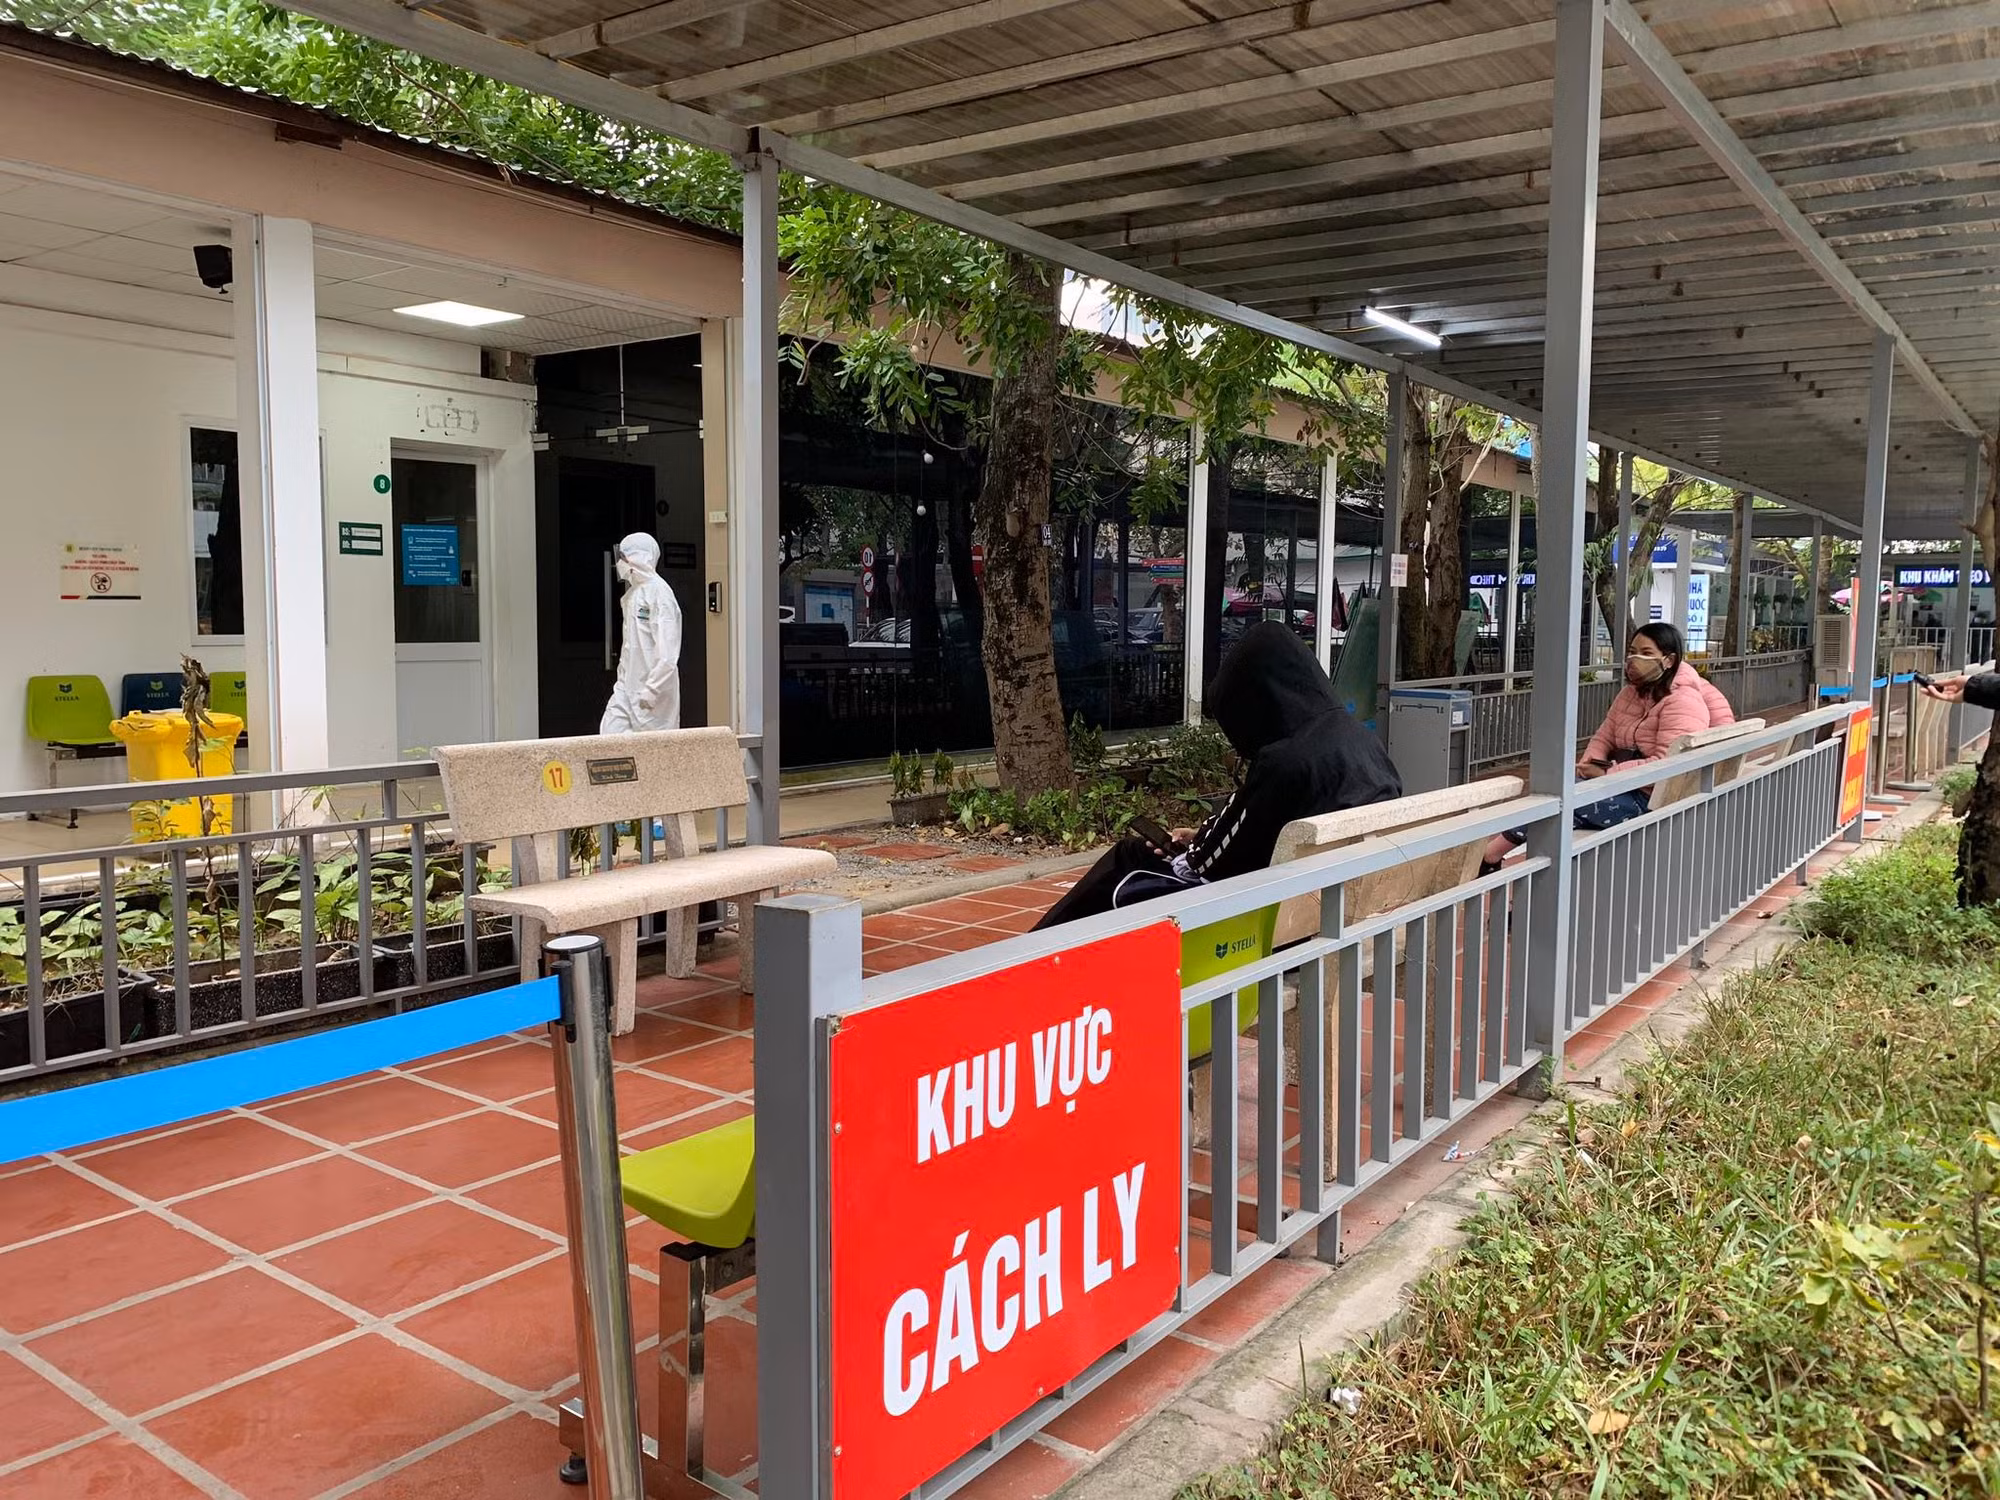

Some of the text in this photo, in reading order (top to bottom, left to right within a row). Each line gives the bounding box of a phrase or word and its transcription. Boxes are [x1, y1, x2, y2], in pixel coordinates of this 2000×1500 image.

[379, 479, 386, 489] 8
[1900, 570, 1922, 584] KHU
[1923, 567, 1955, 584] KHÁM
[549, 767, 563, 788] 17
[1231, 934, 1256, 954] STELLA
[917, 1005, 1112, 1164] KHU VỰC
[883, 1162, 1146, 1417] CÁCH LY
